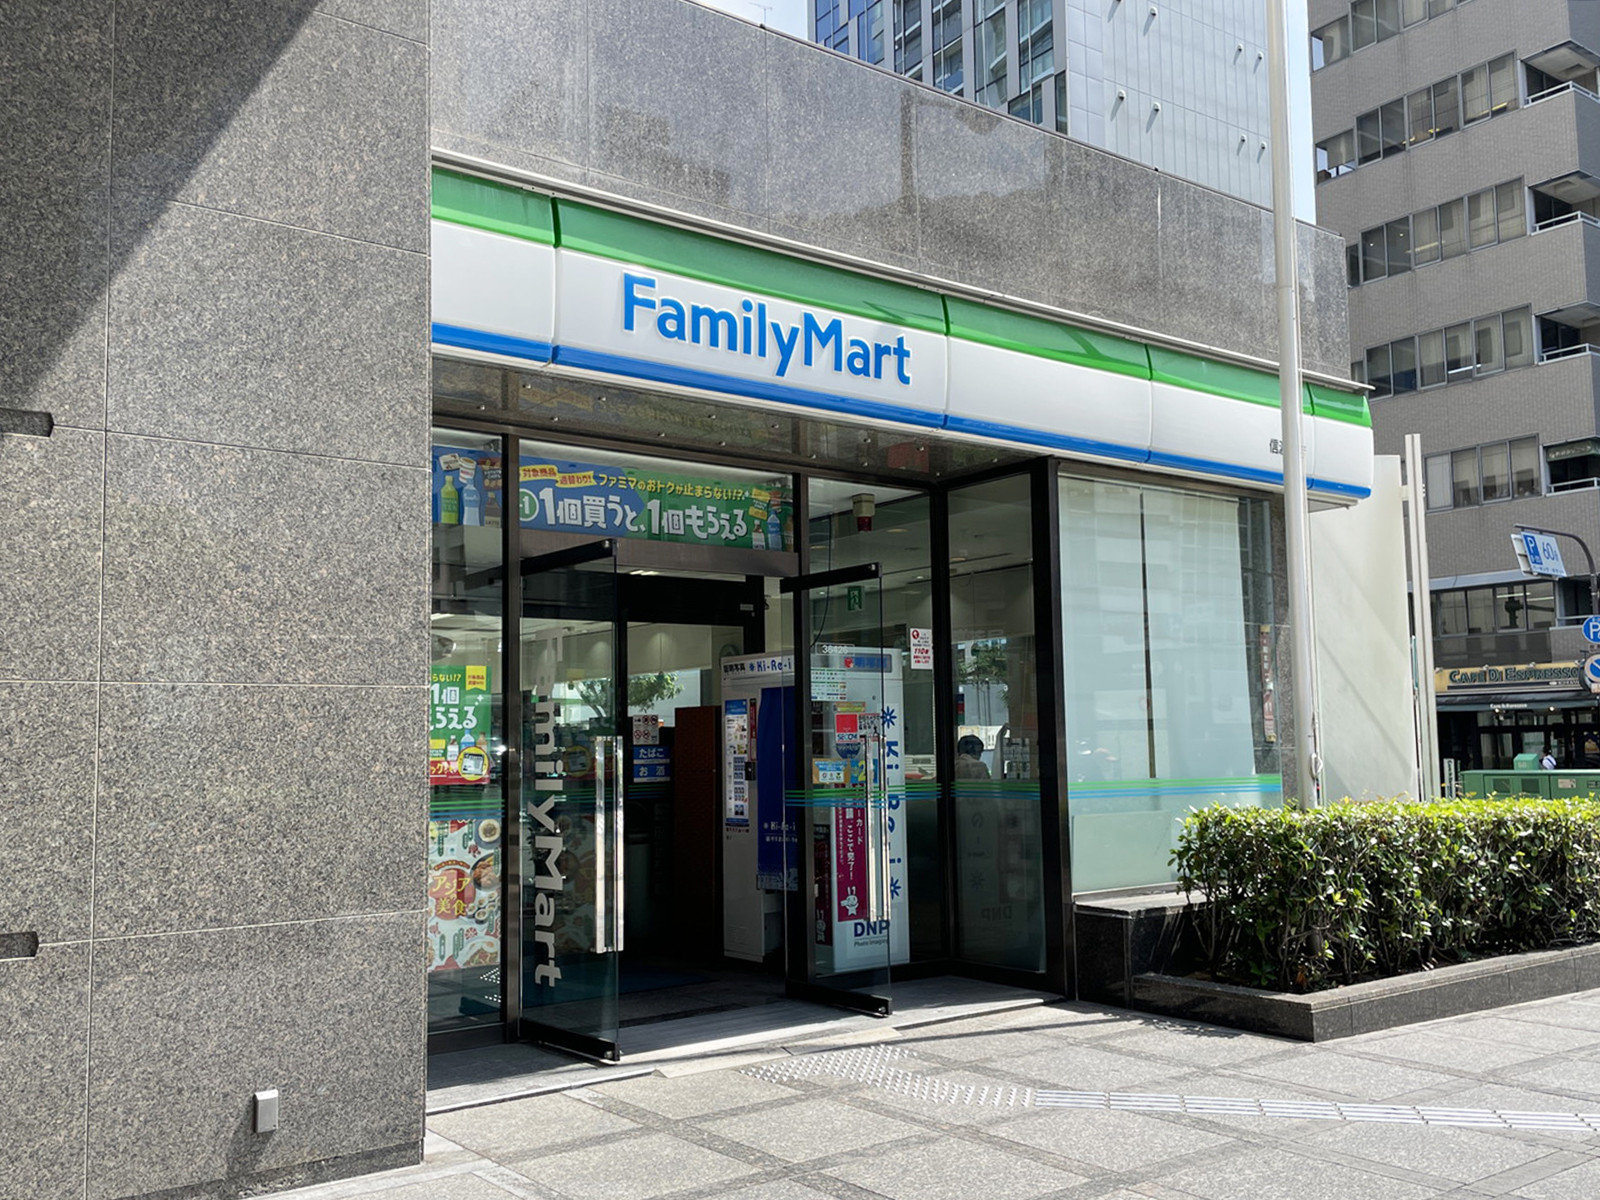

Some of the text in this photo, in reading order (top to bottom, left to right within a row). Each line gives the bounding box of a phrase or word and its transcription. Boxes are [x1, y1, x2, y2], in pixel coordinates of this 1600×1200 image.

[624, 273, 910, 385] FamilyMart
[1526, 537, 1535, 553] P
[430, 706, 478, 729] らえる
[639, 748, 665, 758] たばこ
[433, 876, 471, 895] アジア
[438, 898, 467, 915] 美食
[854, 920, 890, 938] DNP
